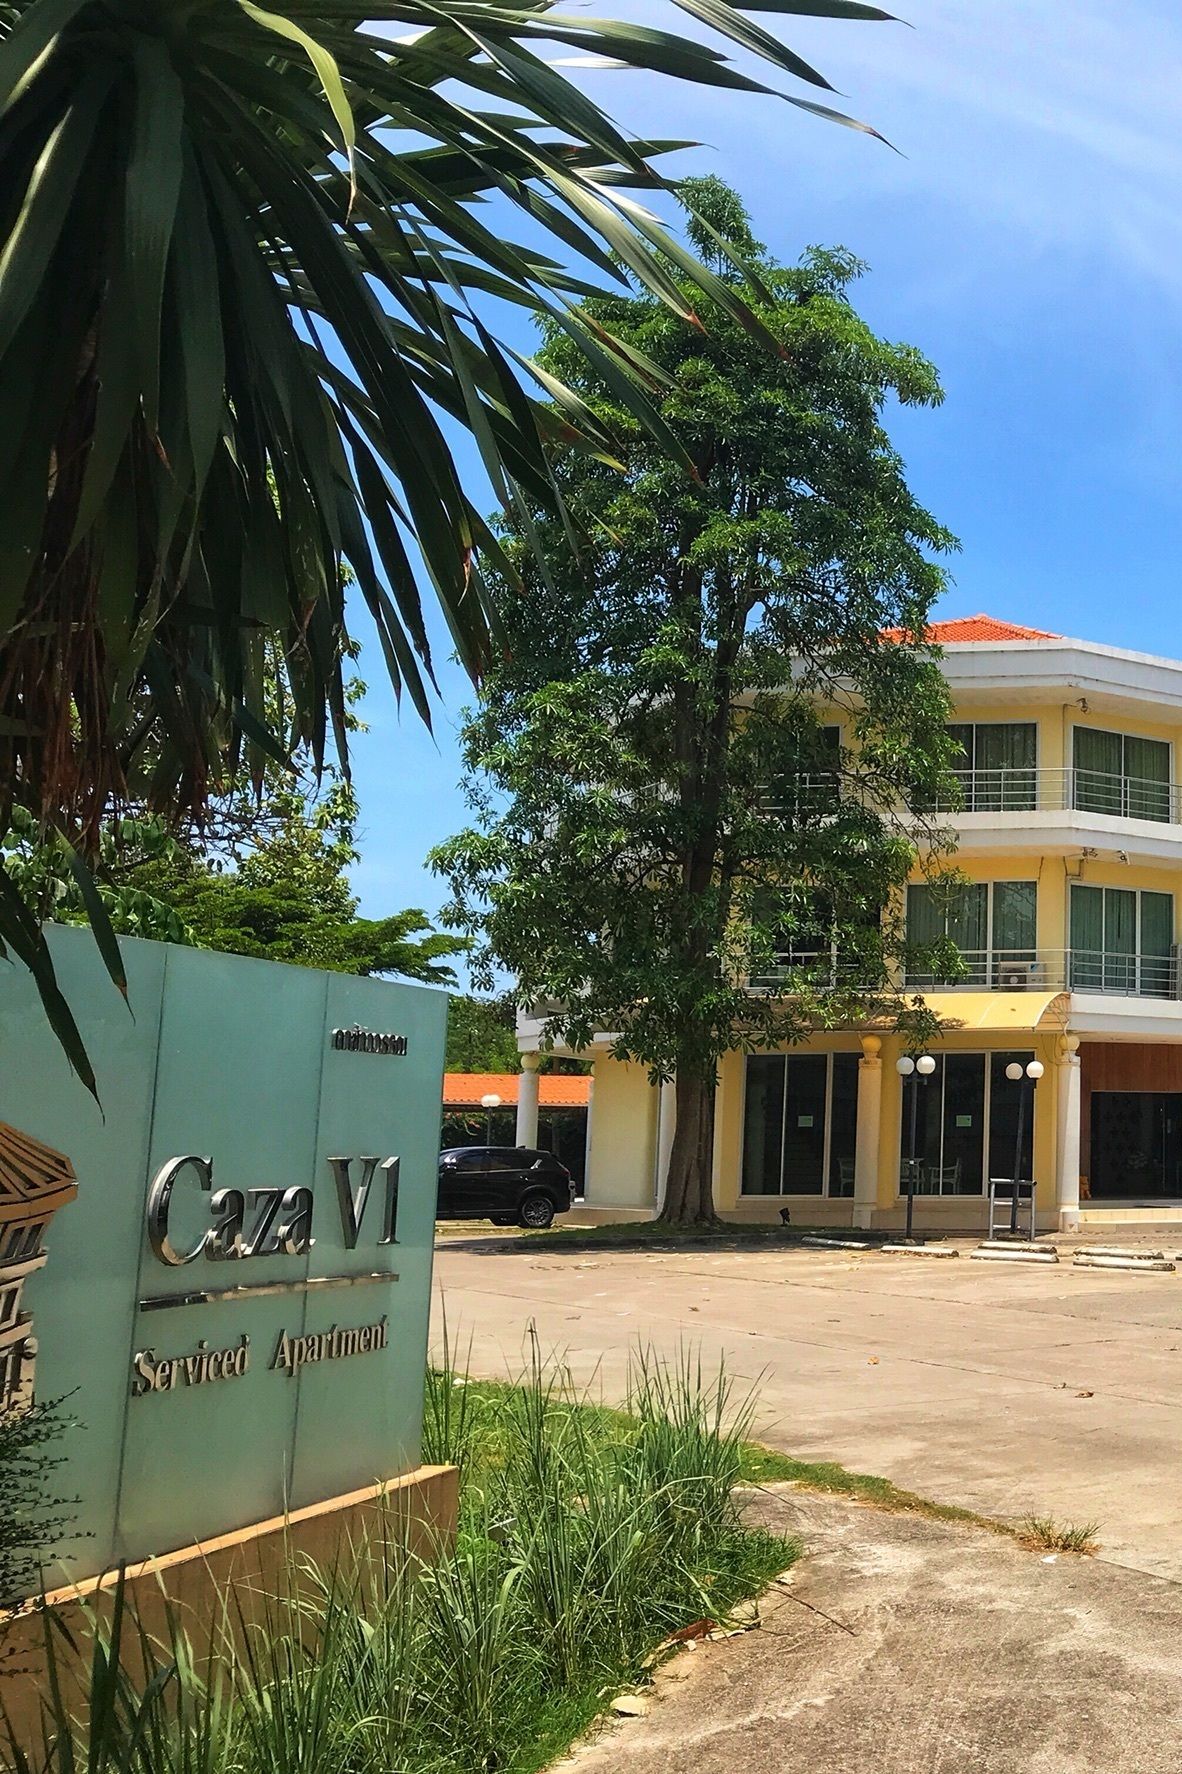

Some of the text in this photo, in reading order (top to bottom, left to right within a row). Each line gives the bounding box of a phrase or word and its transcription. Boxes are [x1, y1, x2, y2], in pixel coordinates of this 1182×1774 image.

[148, 1155, 316, 1266] Caza
[132, 1315, 389, 1397] Serviced Apartment
